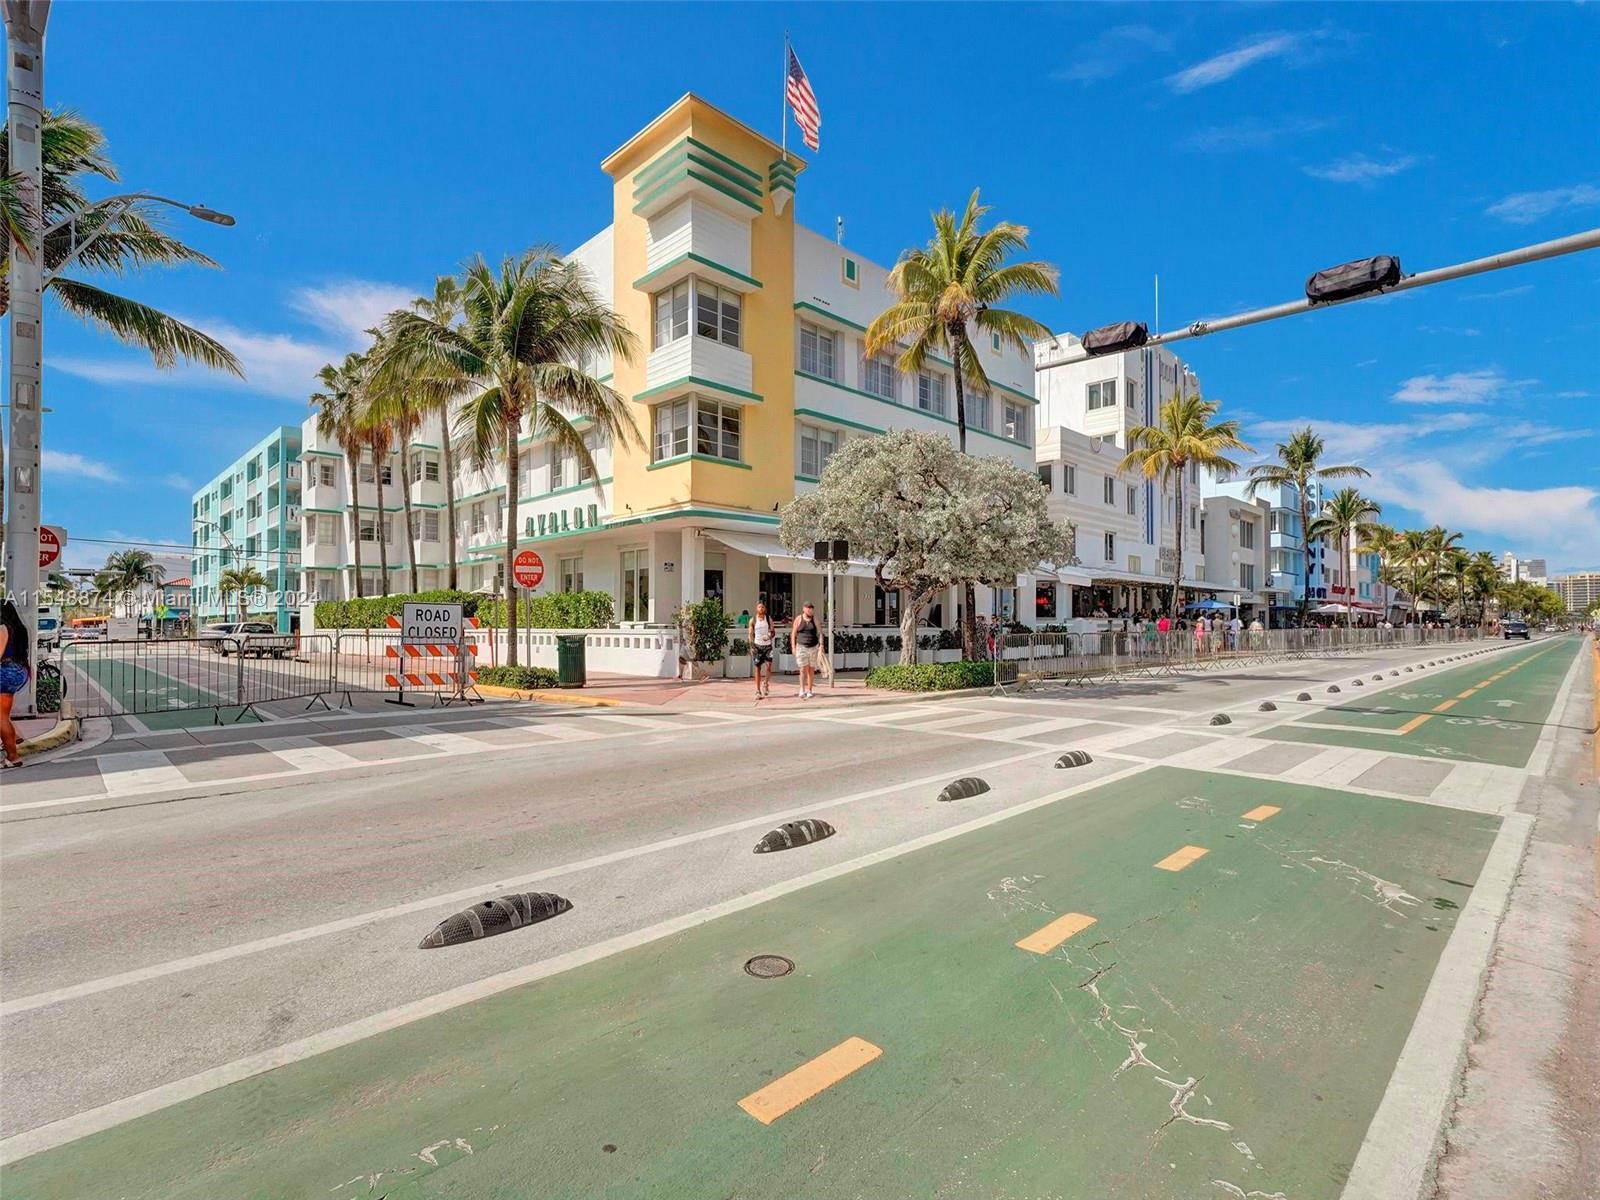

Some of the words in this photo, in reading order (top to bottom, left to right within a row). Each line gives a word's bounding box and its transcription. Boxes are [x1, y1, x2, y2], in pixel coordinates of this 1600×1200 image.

[525, 503, 598, 537] AVALON
[527, 557, 540, 565] NOT
[415, 608, 451, 622] ROAD
[408, 625, 457, 639] CLOSED
